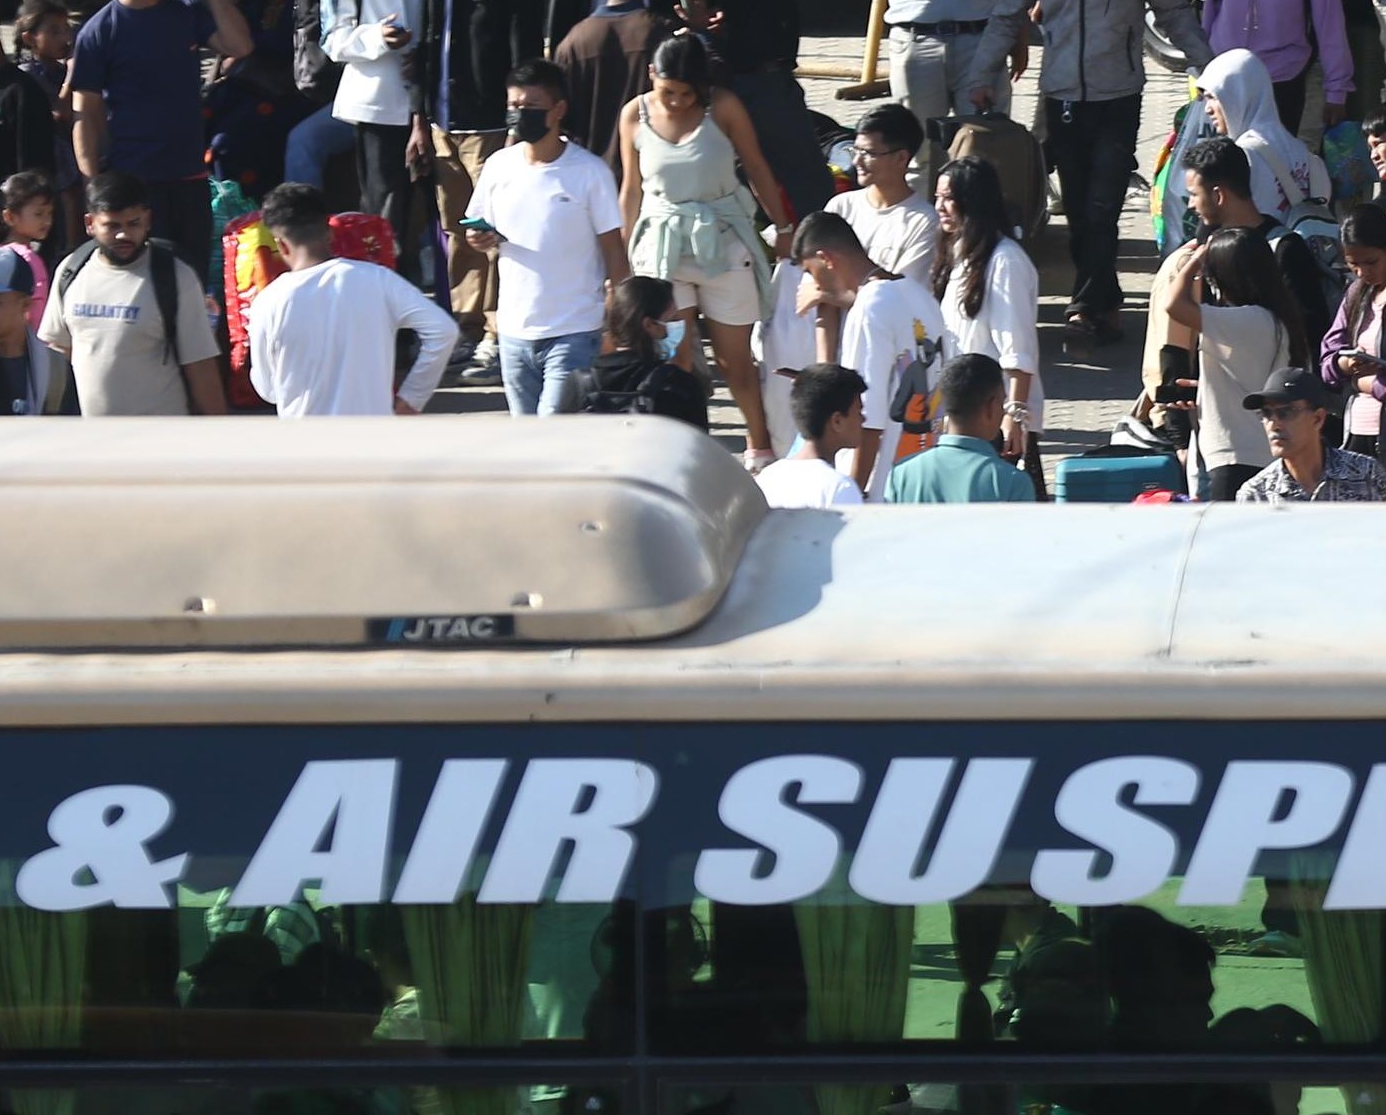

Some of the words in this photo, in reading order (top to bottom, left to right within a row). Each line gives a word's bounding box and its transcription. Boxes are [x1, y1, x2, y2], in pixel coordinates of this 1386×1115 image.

[73, 303, 141, 321] GALLANTRY
[403, 616, 497, 641] JTAC
[15, 784, 188, 912] &
[230, 757, 658, 908] AIR
